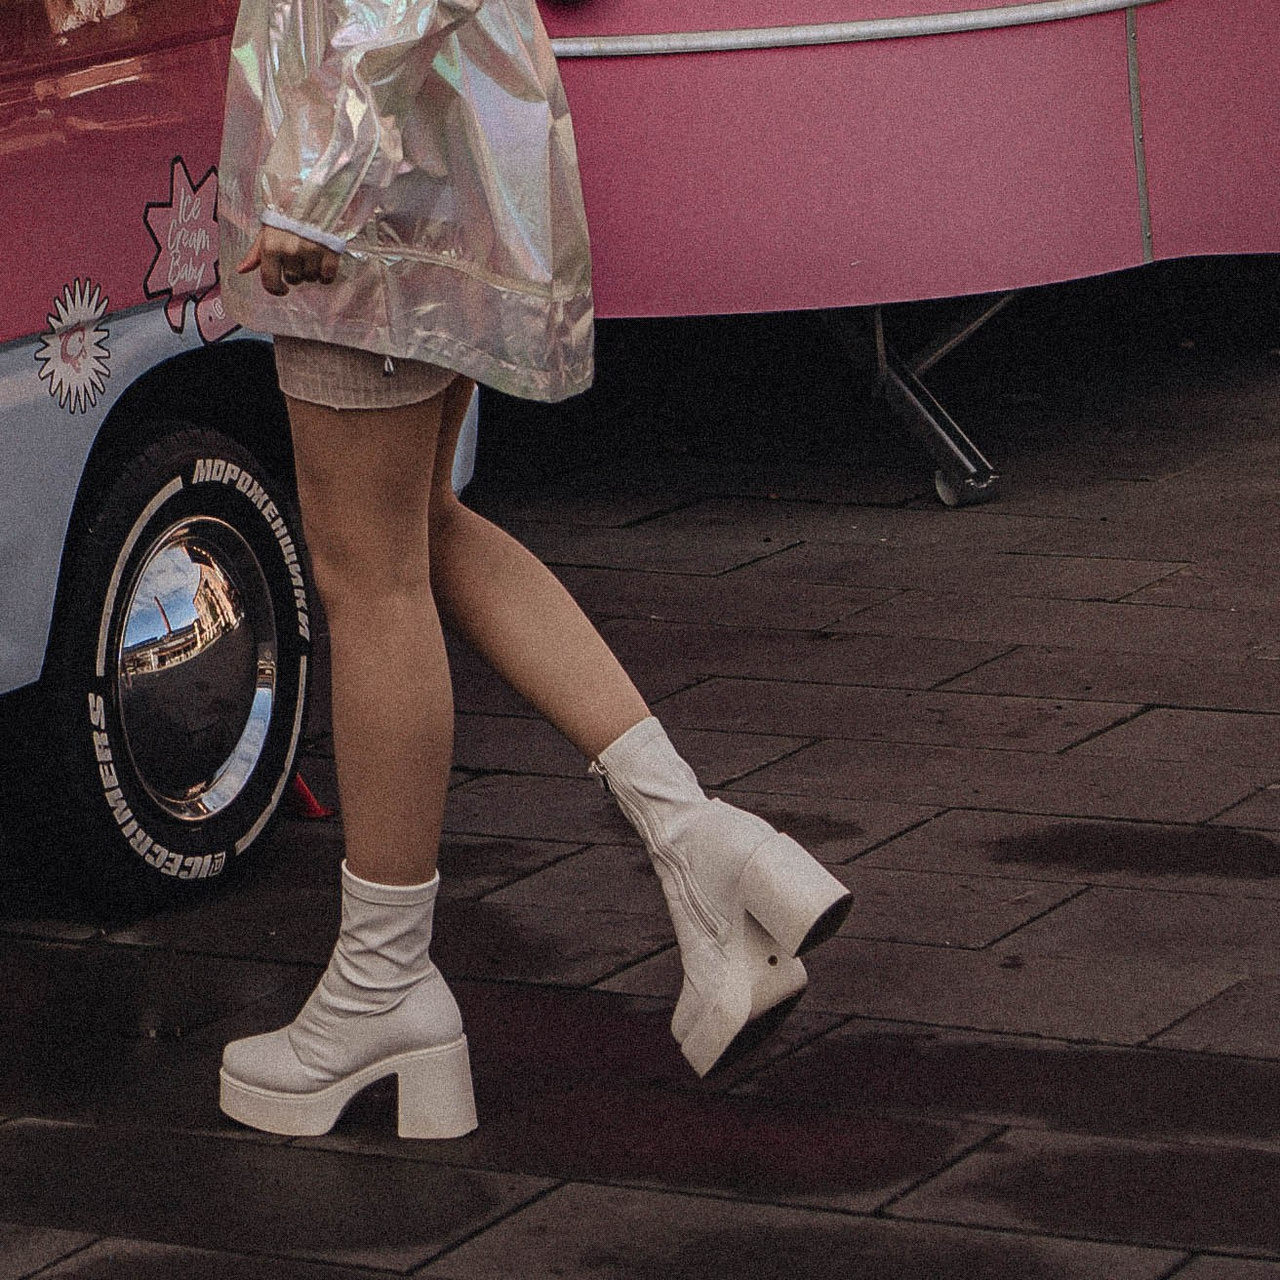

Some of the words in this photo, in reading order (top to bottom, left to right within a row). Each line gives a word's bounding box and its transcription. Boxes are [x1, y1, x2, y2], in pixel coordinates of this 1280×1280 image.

[178, 187, 201, 224] Ice
[168, 219, 211, 257] Cream
[168, 250, 206, 290] Baby
[191, 458, 311, 642] МОРОЖЕНЩИКИ
[88, 692, 227, 880] @ICECRIMERS
